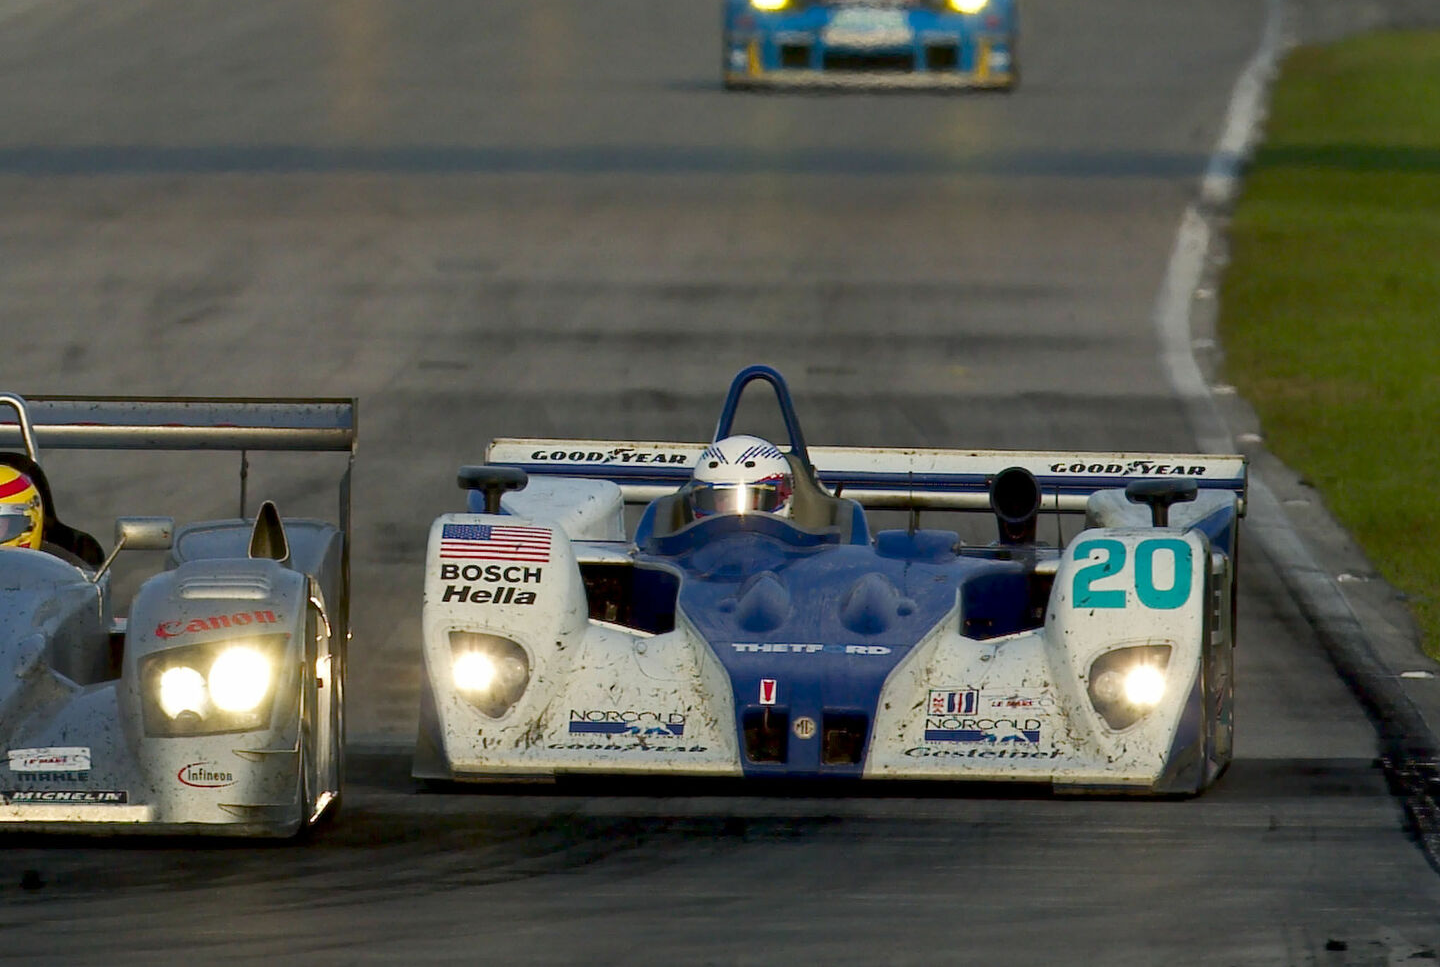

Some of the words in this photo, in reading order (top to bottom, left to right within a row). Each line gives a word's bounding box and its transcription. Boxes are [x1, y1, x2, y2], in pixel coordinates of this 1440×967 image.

[440, 564, 542, 584] BOSCH
[1071, 539, 1193, 610] 20
[442, 585, 537, 605] Hella
[155, 610, 277, 639] Canon
[731, 643, 892, 655] THETFORD
[570, 709, 686, 724] NORCOLD
[925, 718, 1042, 730] NORCOLD
[11, 791, 122, 801] MICHELIN
